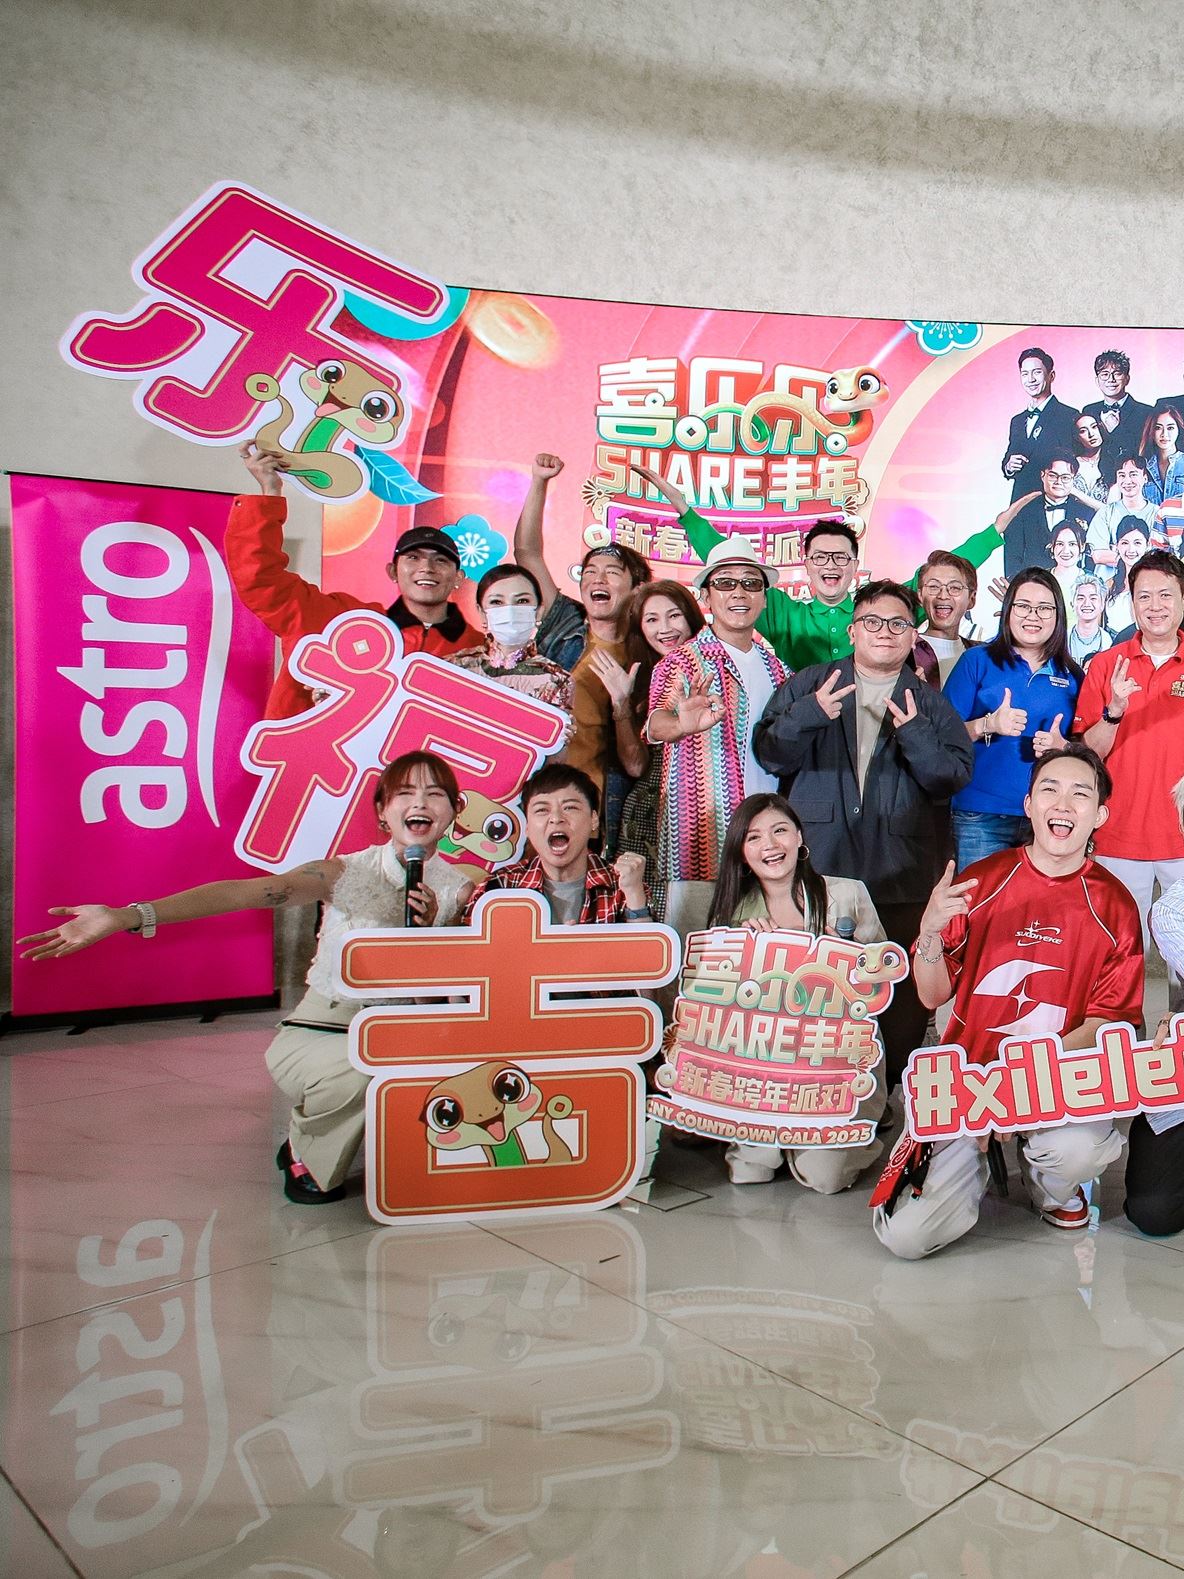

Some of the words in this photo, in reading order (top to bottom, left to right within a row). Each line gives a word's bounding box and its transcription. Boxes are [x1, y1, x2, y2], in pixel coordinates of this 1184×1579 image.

[71, 187, 444, 437] 乐
[595, 445, 767, 512] SHARE
[767, 455, 860, 512] 丰年
[56, 521, 190, 829] astro
[682, 928, 869, 1019] 喜乐乐
[342, 897, 671, 1218] 吉
[676, 1001, 801, 1064] SHARE
[799, 1020, 875, 1067] 丰年
[676, 1107, 776, 1143] COUNTDOWN
[777, 1128, 822, 1144] GALA
[826, 1127, 872, 1144] 2025
[680, 1062, 850, 1112] 新春跨年派对
